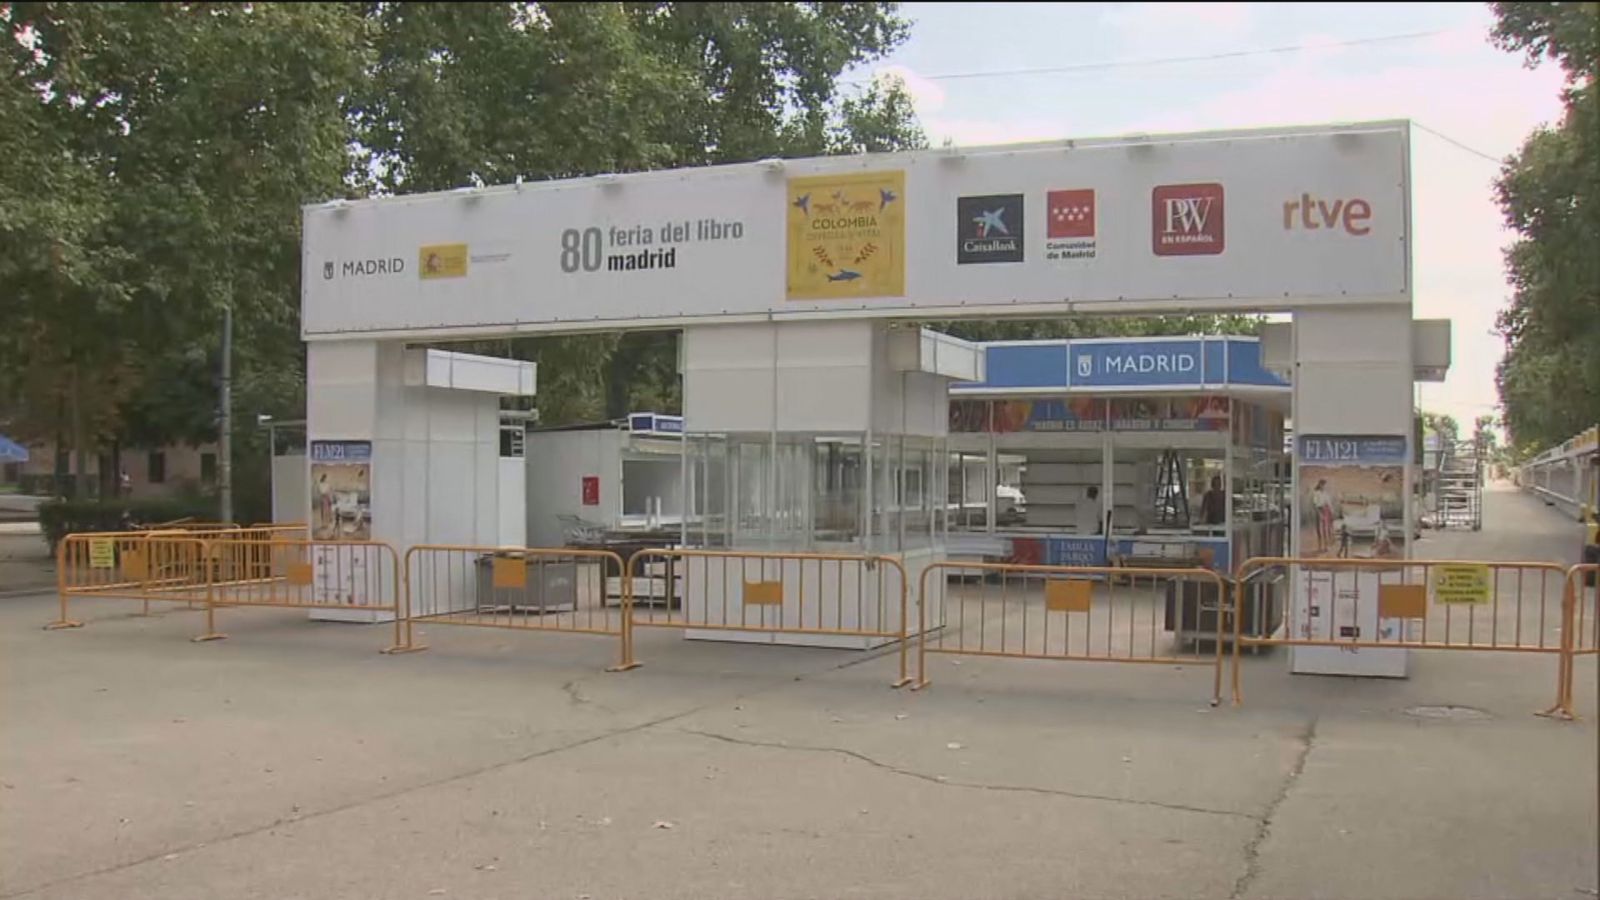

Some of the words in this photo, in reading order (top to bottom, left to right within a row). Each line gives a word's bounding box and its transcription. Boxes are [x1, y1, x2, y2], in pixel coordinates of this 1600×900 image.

[812, 216, 878, 231] COLOMBIA
[1162, 197, 1215, 234] PW
[1283, 193, 1372, 236] rtve
[609, 225, 653, 247] feria
[660, 221, 690, 244] del
[698, 218, 743, 241] libro
[1161, 236, 1174, 244] EN
[1176, 233, 1213, 243] ESPAÑOL
[560, 226, 603, 273] 80
[964, 240, 1017, 252] CaixaBank
[1046, 241, 1096, 250] Comunidad
[1046, 251, 1059, 259] de
[1061, 250, 1096, 259] Madrid
[342, 258, 405, 276] MADRID
[608, 247, 676, 271] madrid
[1105, 354, 1195, 373] MADRID
